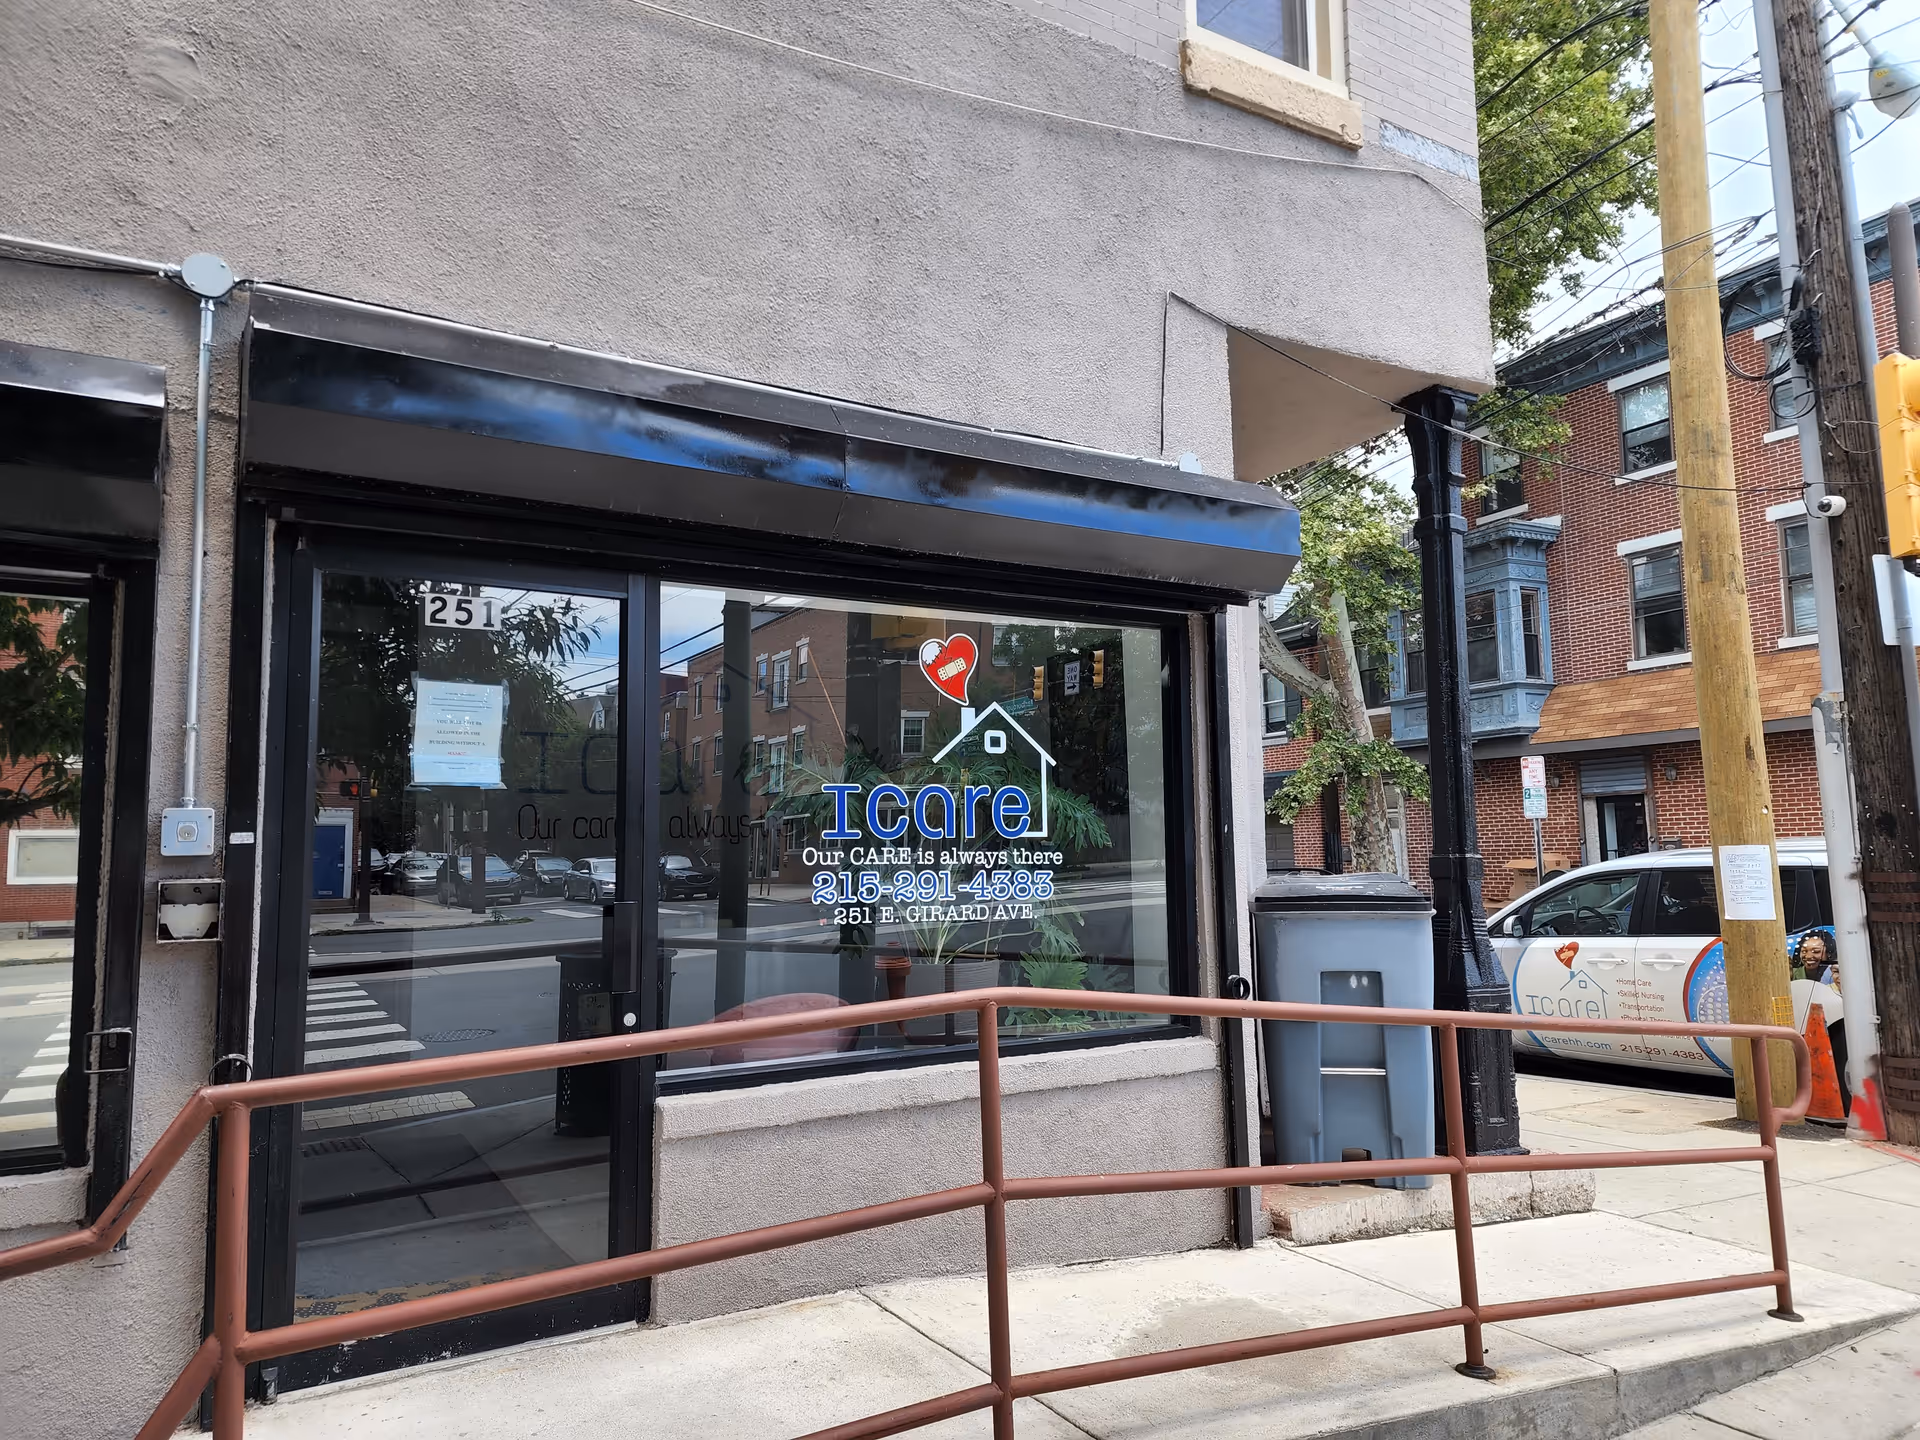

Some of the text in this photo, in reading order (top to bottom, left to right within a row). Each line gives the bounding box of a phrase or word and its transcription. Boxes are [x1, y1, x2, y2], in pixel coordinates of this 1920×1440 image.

[430, 596, 494, 628] 251
[518, 804, 561, 840] Our
[572, 815, 617, 840] car
[669, 805, 751, 845] always
[821, 784, 1031, 840] Icare
[802, 847, 1063, 867] Our CARE is always there
[811, 869, 1055, 905] 215-291-4383
[833, 903, 1039, 925] 251 E. GIRARD AVE.
[1618, 978, 1652, 987] Home Care
[1619, 989, 1665, 1001] Skilled Nursing
[1621, 1002, 1665, 1013] Transportation
[1540, 1033, 1704, 1061] icarehh.com 215-291-4383
